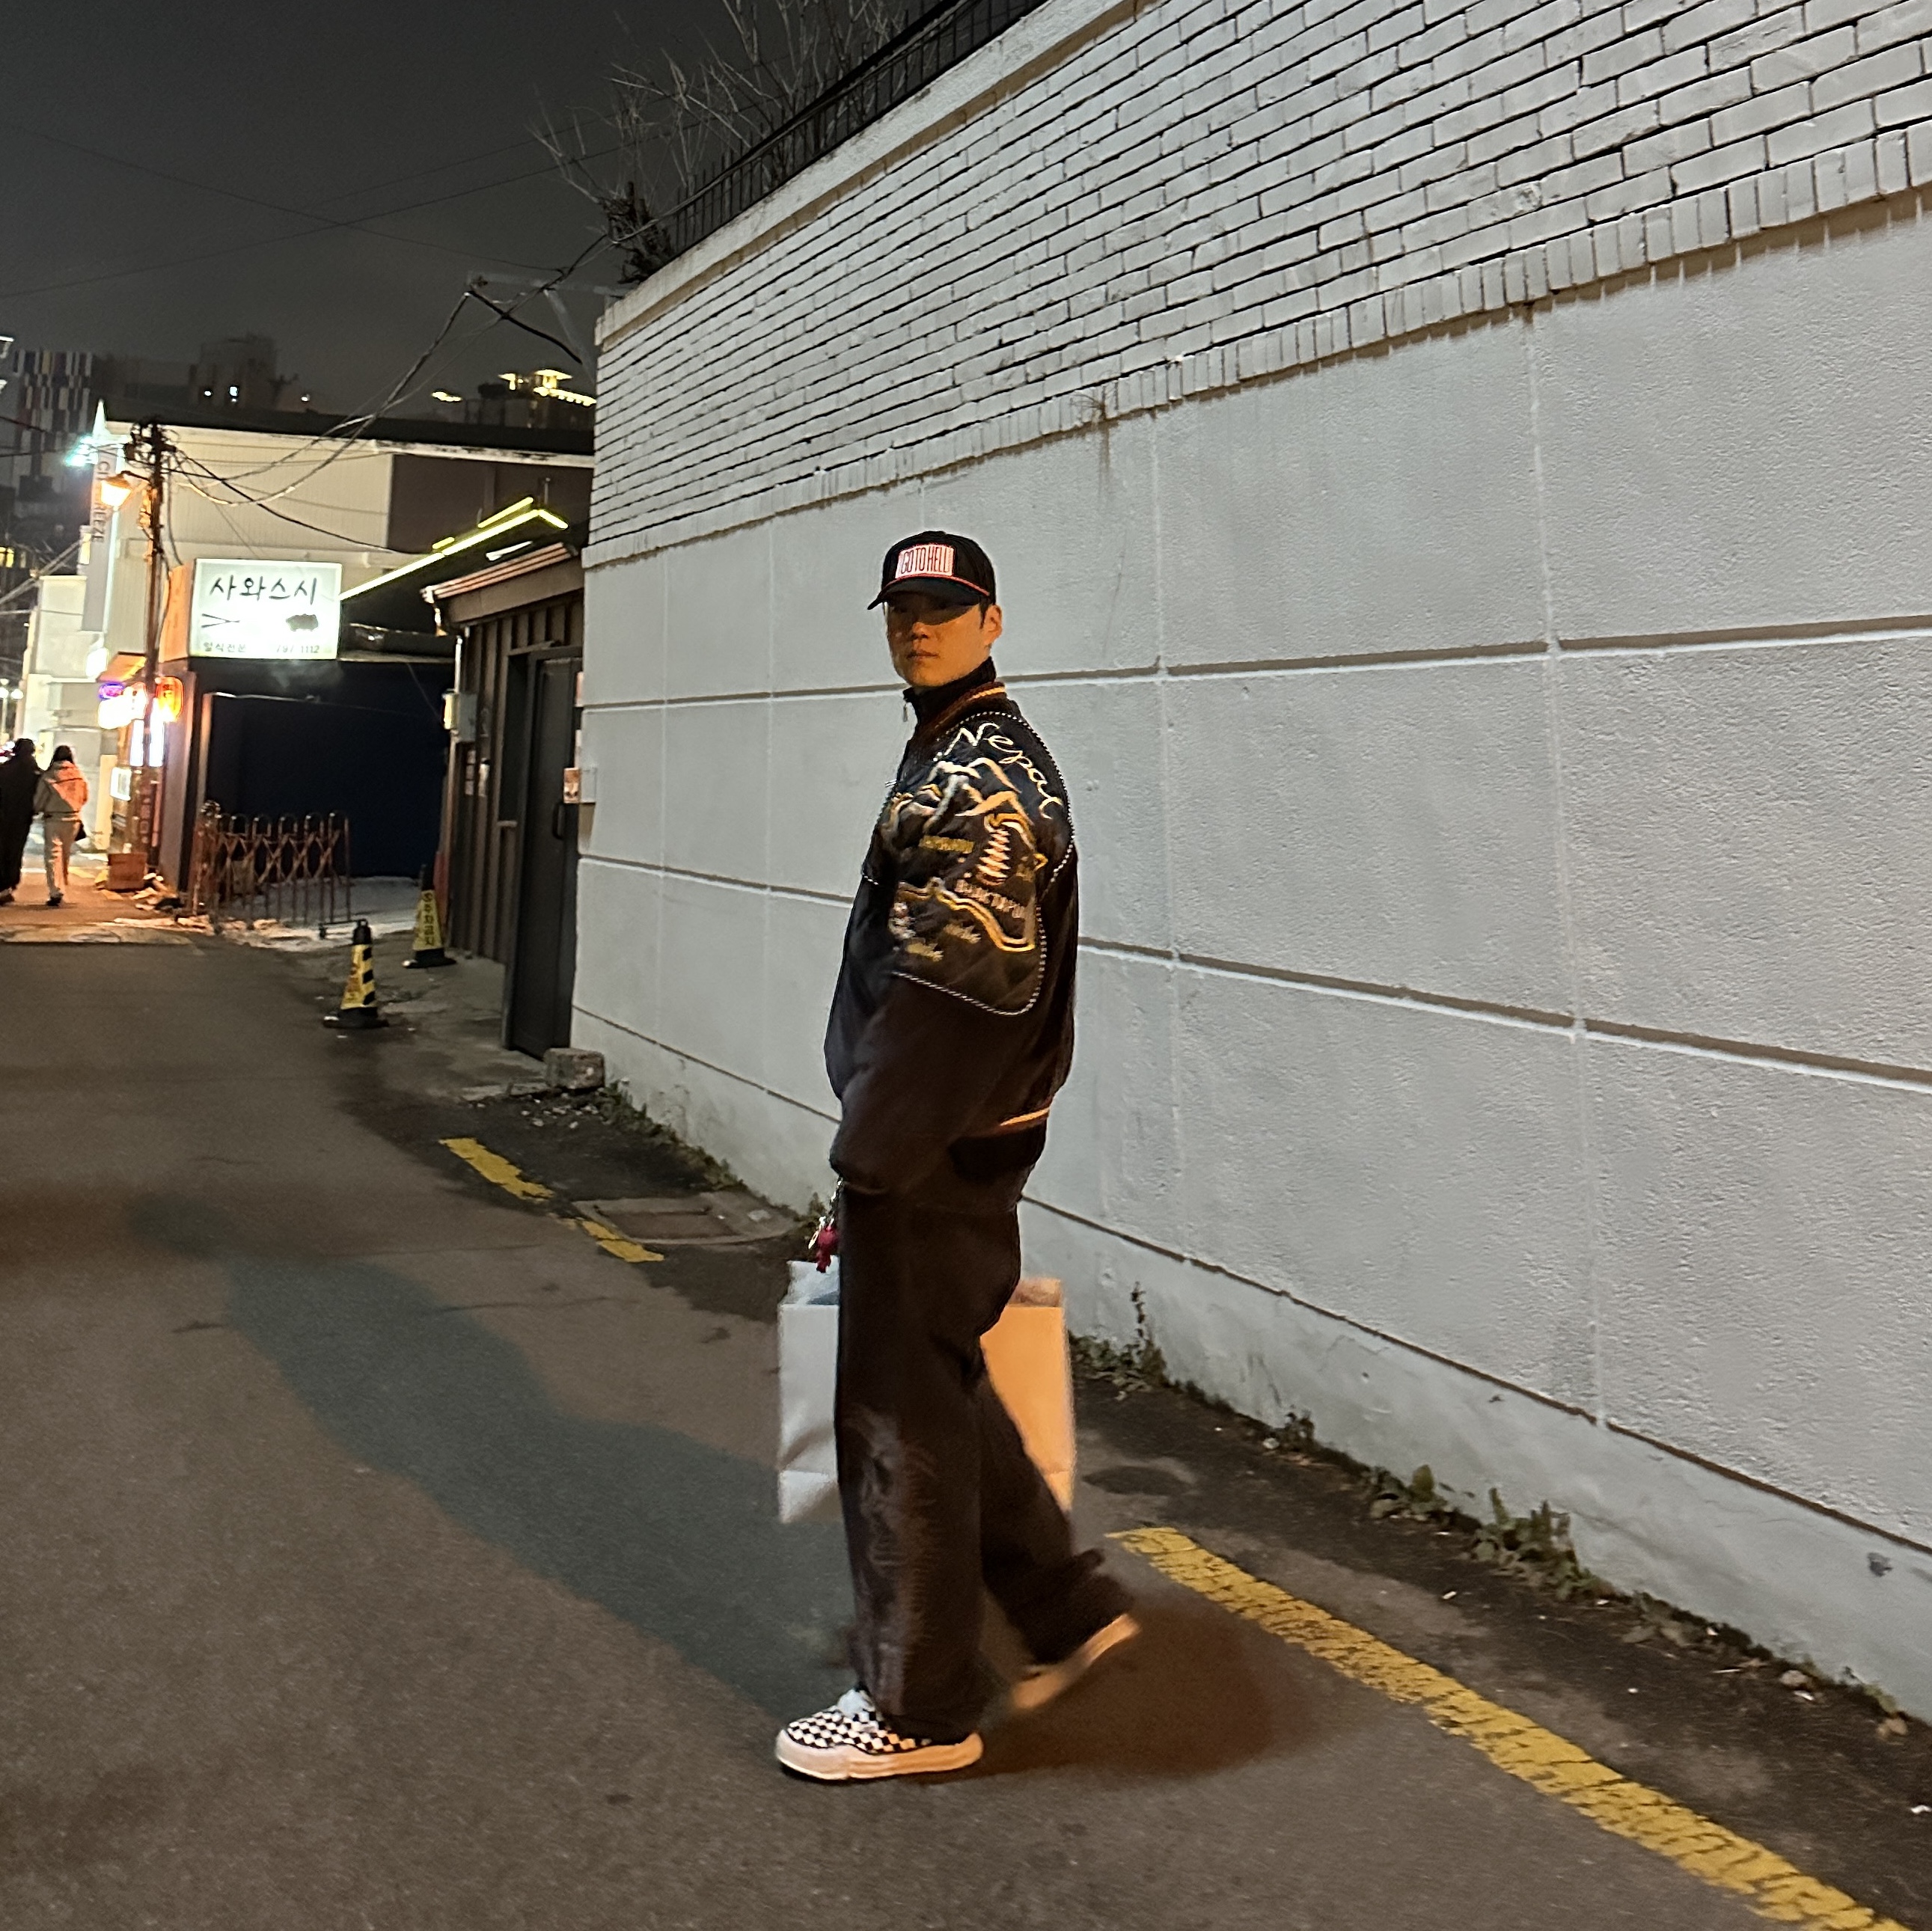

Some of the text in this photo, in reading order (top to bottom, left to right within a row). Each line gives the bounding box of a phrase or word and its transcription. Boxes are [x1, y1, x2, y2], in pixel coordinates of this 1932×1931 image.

[900, 545, 950, 575] GO TO HELL
[209, 574, 317, 606] 사와스시
